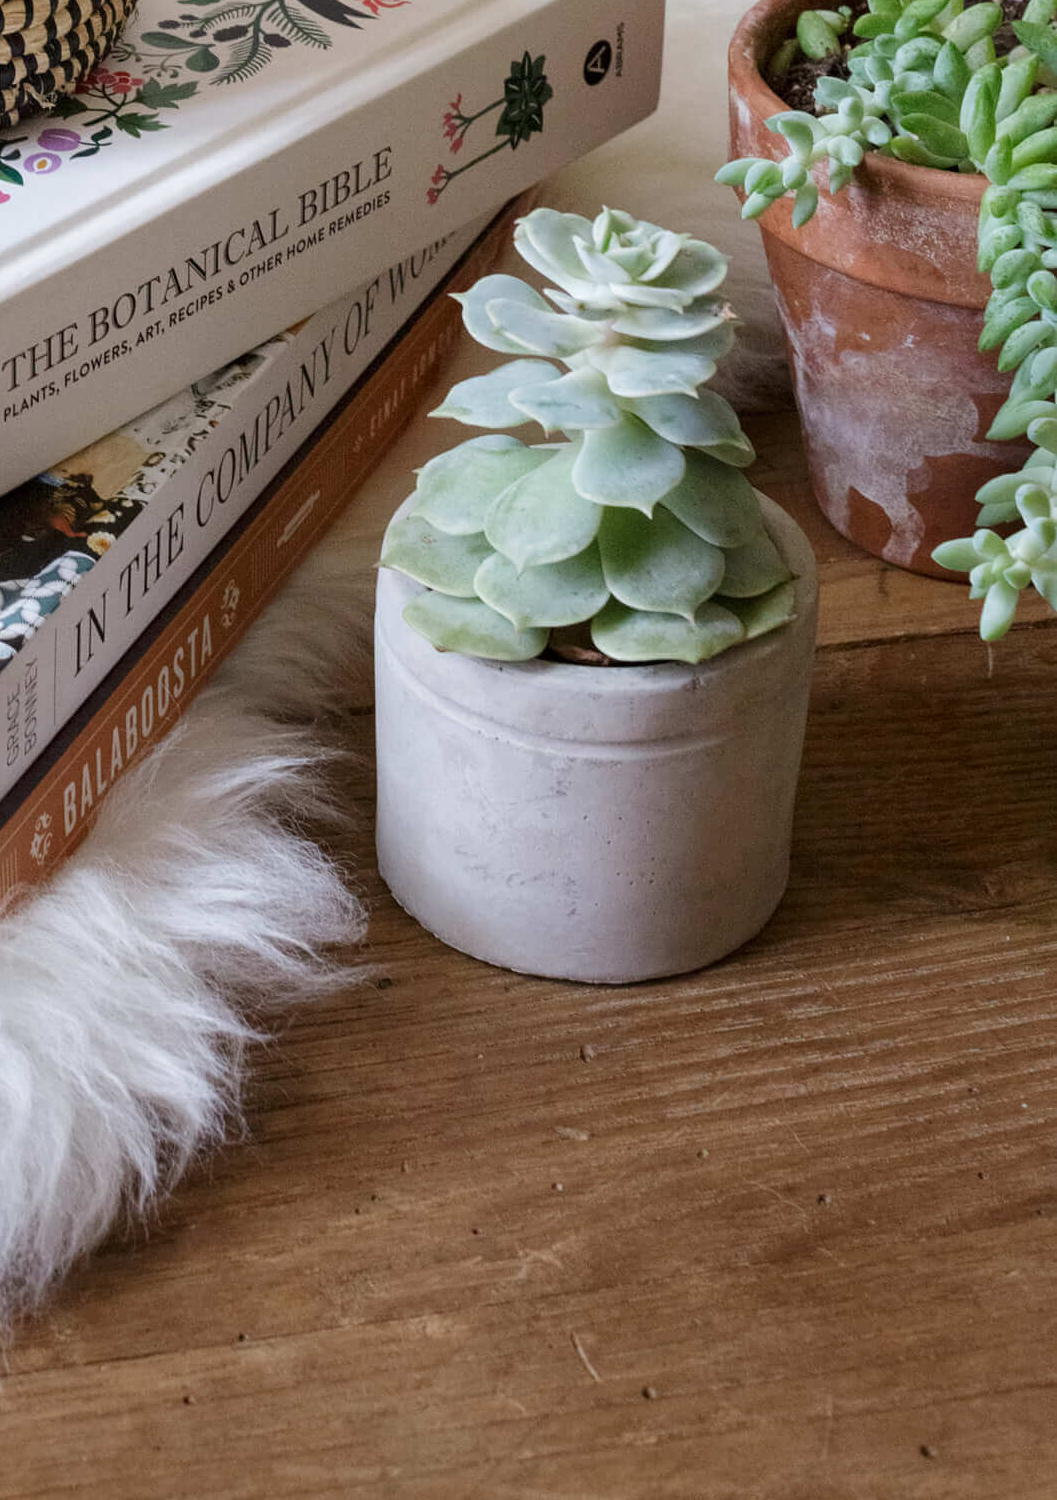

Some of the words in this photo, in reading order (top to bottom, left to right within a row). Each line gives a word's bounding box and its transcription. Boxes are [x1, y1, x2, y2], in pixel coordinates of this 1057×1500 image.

[1, 322, 79, 393] THE
[87, 207, 290, 347] BOTANICAL
[297, 146, 393, 228] BIBLE
[3, 382, 61, 423] PLANTS,
[64, 339, 133, 388] FLOWERS,
[135, 321, 165, 347] ART,
[169, 286, 223, 328] RECIPES
[226, 279, 236, 294] &
[239, 253, 283, 287] OTHER
[286, 228, 325, 261] HOME
[328, 190, 391, 237] REMEDIES
[74, 588, 110, 678] IN
[119, 502, 185, 618] THE
[196, 327, 337, 528] COMPANY
[344, 276, 380, 356] OF
[6, 683, 21, 767] GRACE
[24, 658, 39, 757] BONNEY
[63, 612, 213, 837] BALABOOSTA
